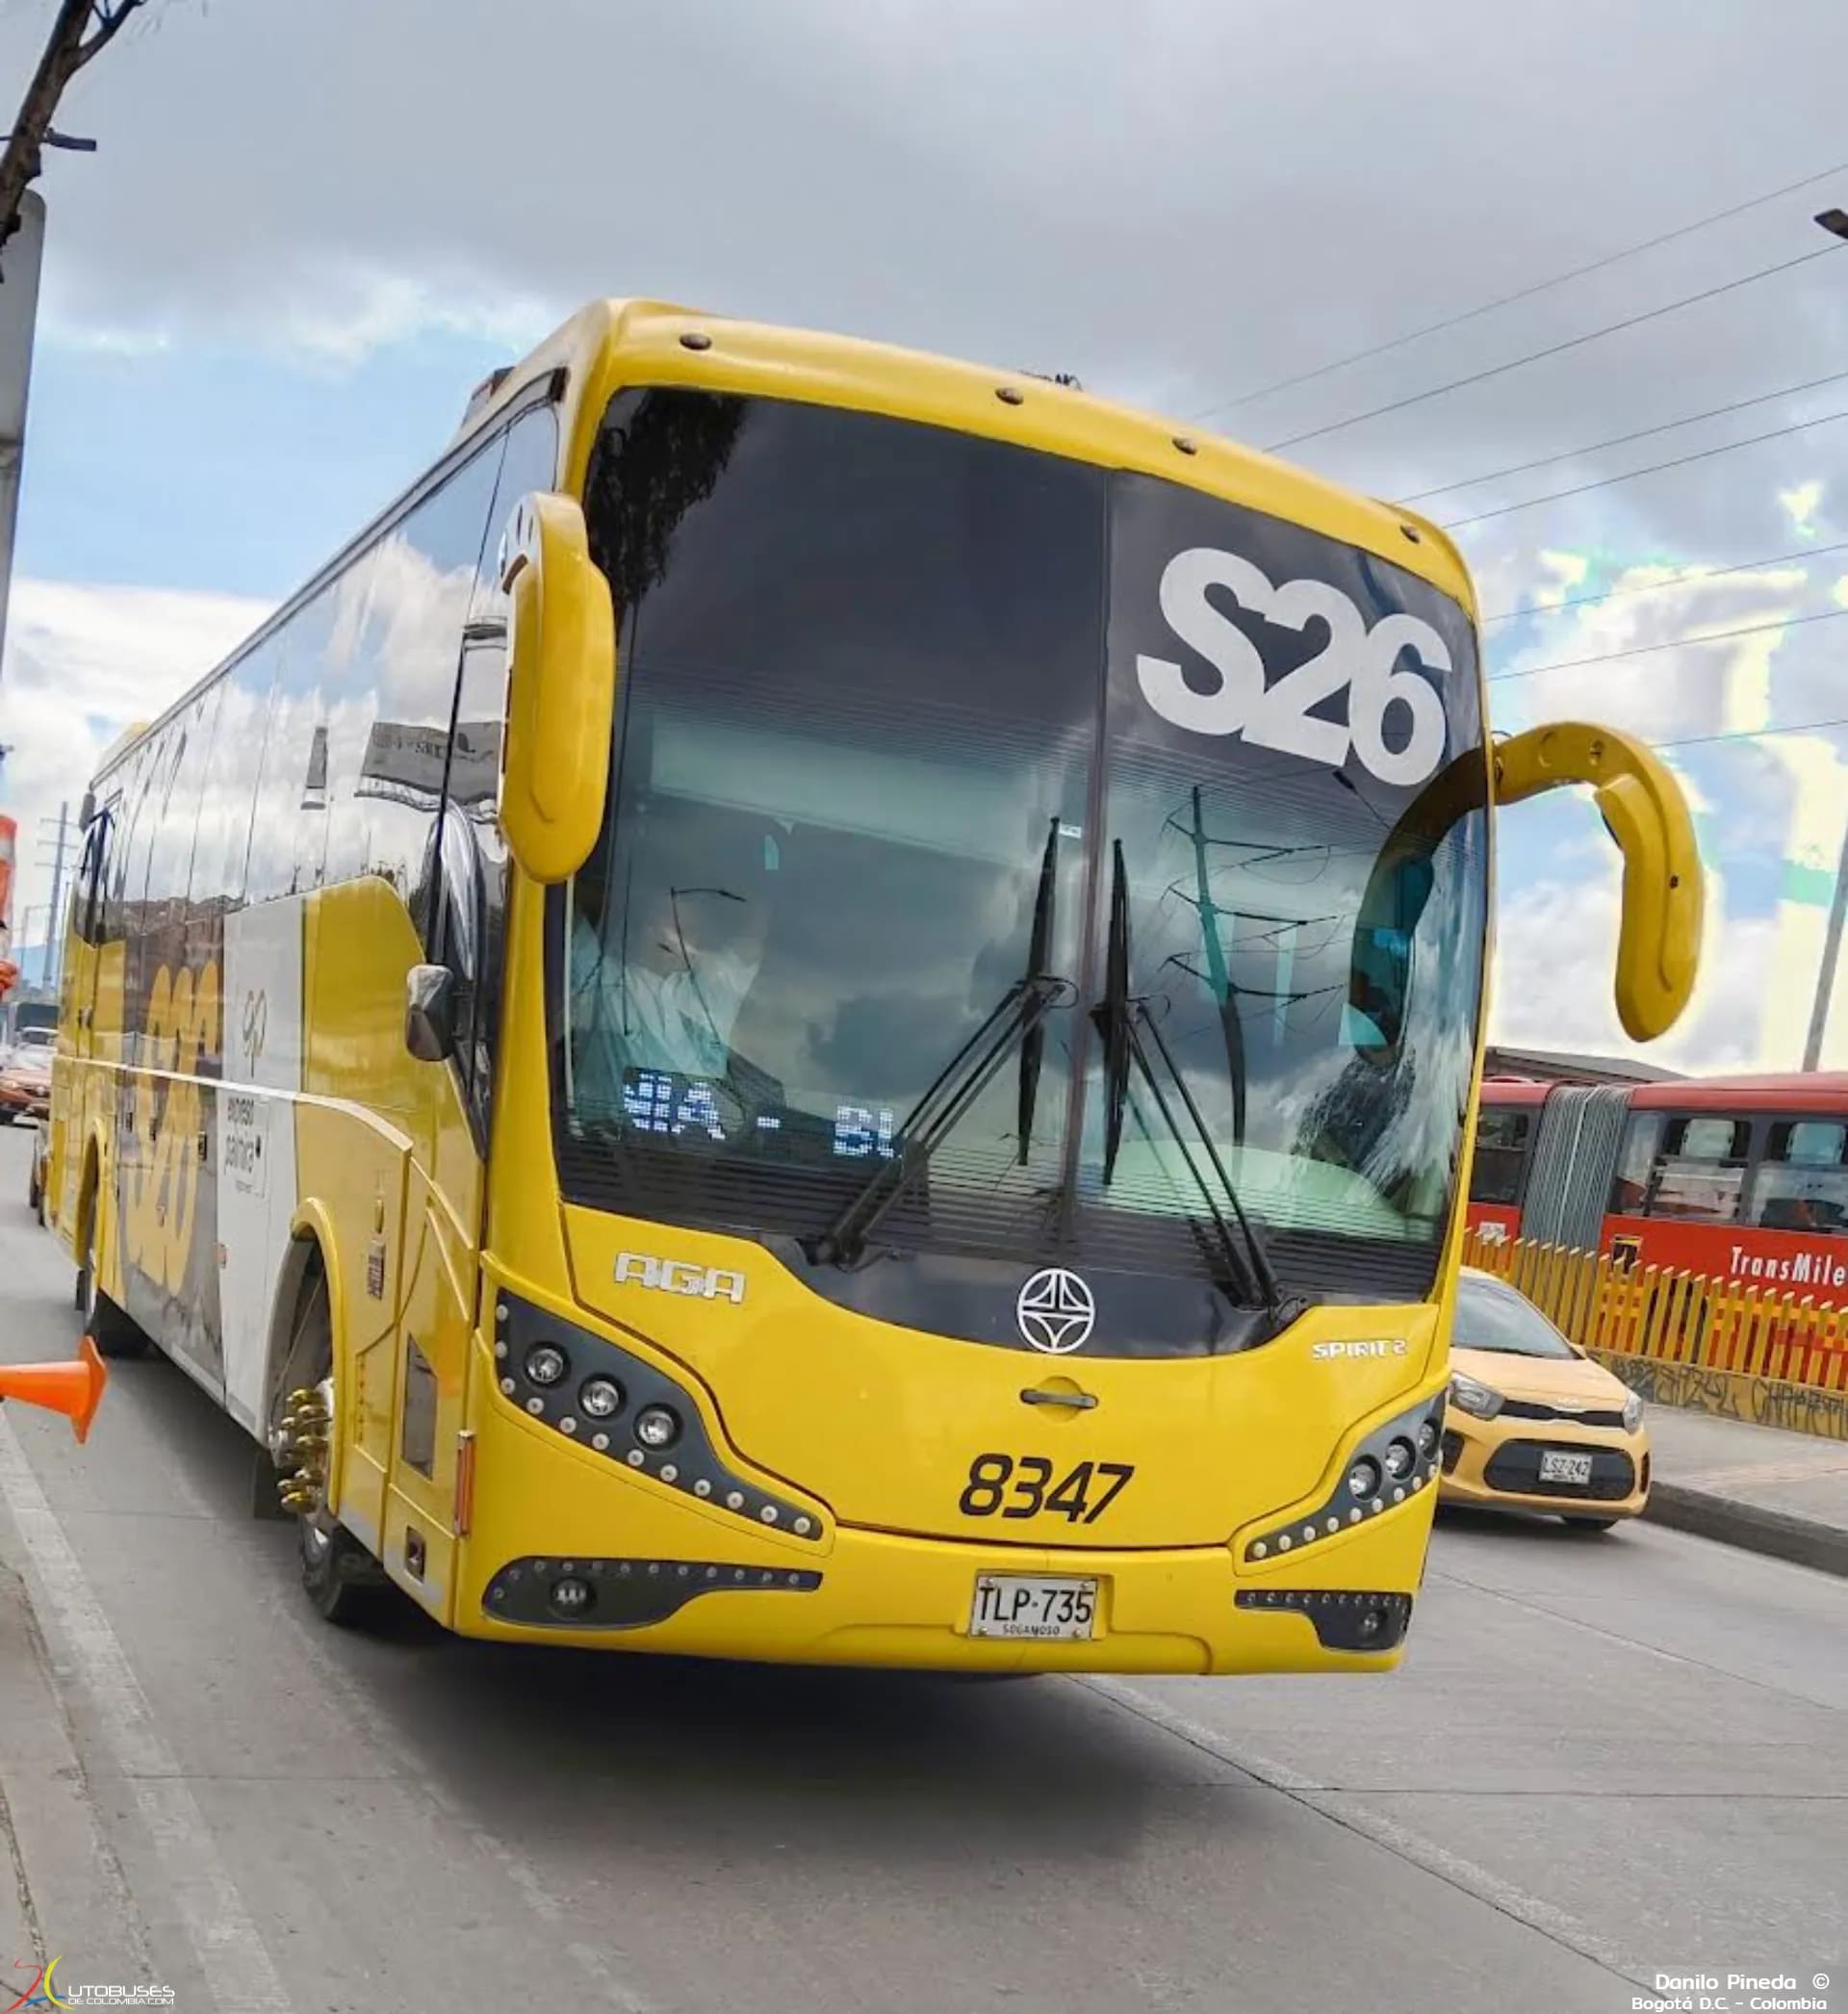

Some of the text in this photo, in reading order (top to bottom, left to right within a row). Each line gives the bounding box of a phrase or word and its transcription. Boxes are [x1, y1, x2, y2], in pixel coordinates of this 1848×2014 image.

[1136, 548, 1452, 786] S26
[614, 1252, 746, 1304] AGA
[1731, 1246, 1846, 1287] TransMile
[959, 1453, 1136, 1524] 8347
[979, 1586, 1094, 1623] TLP-735
